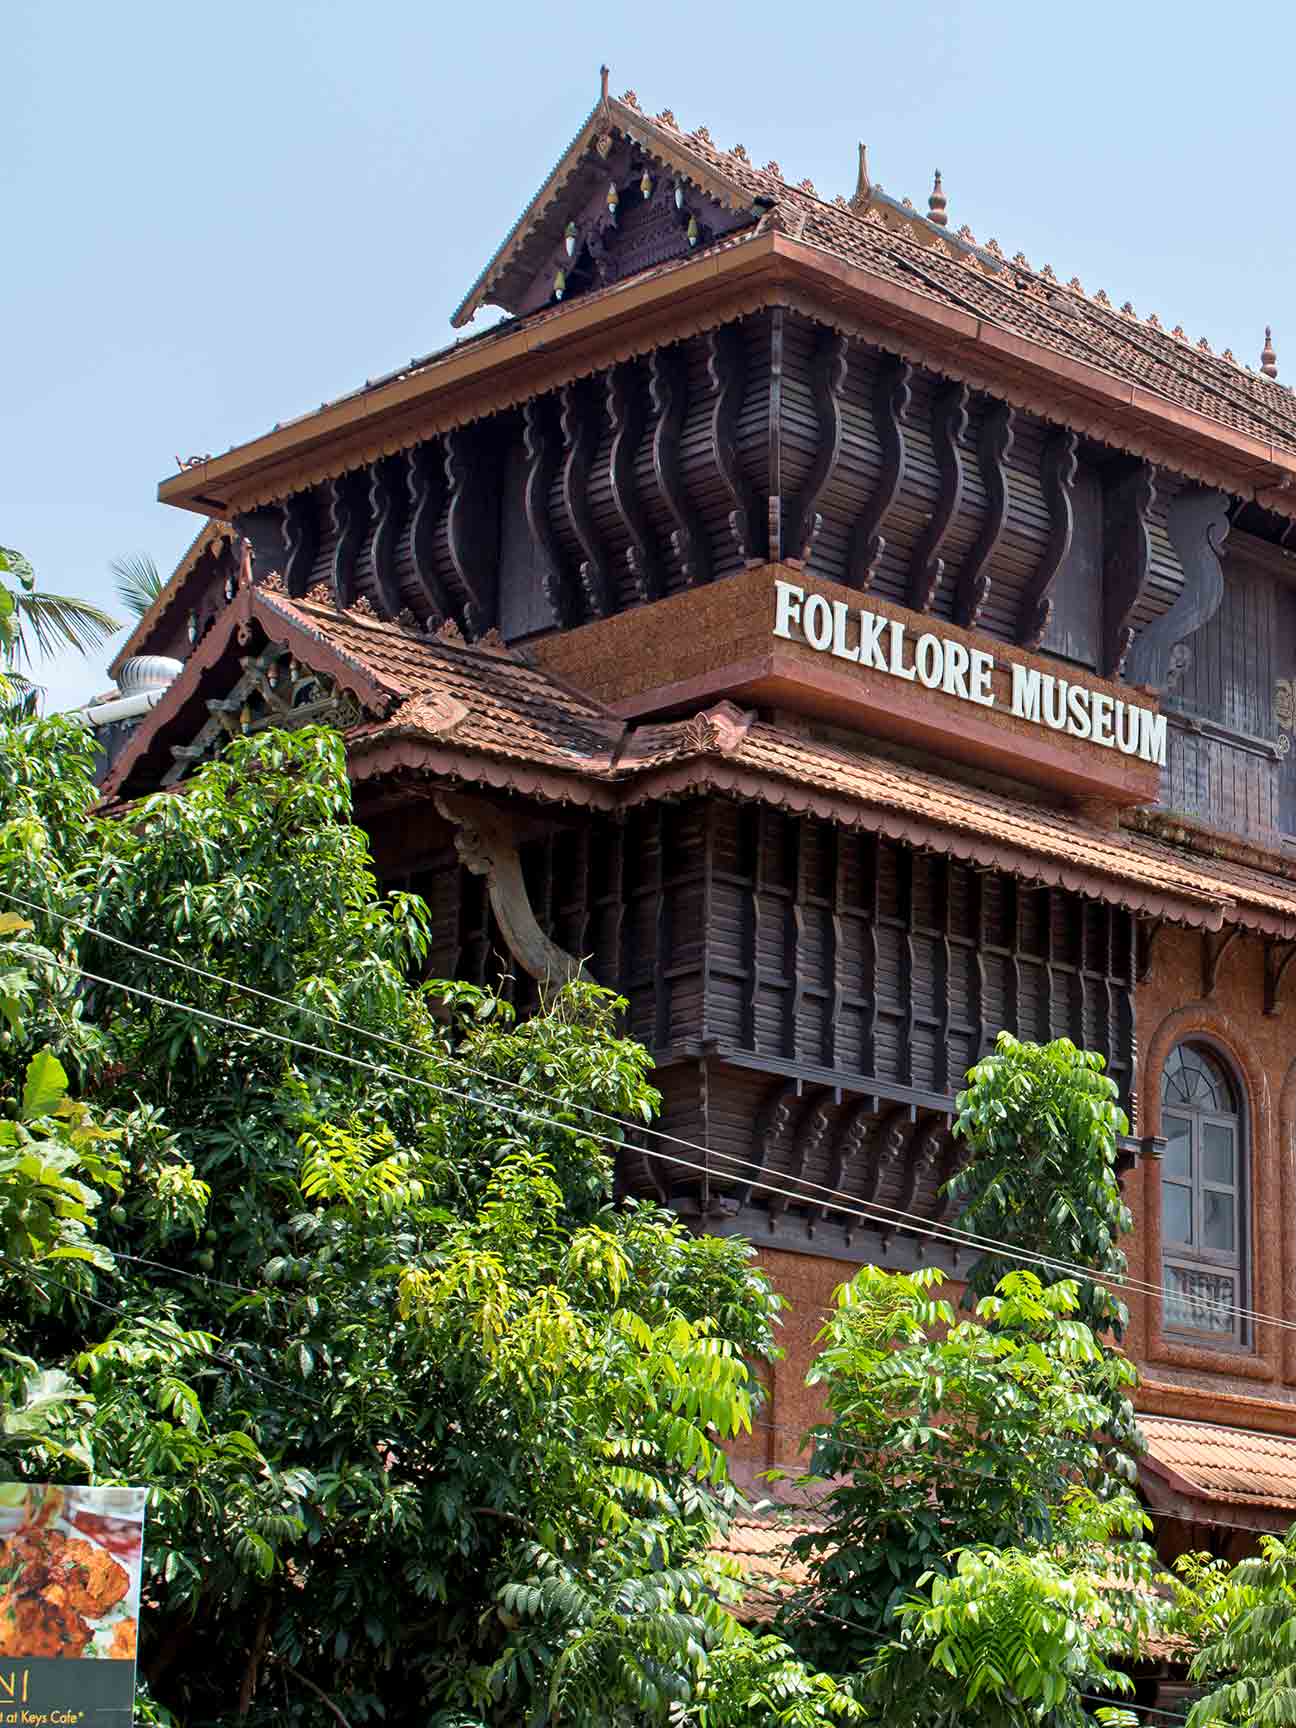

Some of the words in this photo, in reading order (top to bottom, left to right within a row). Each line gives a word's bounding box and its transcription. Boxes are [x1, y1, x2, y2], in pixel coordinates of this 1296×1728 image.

[773, 580, 995, 707] FOLKLORE
[1011, 664, 1168, 767] MUSEUM
[7, 1711, 18, 1724] at
[21, 1710, 48, 1727] Keys
